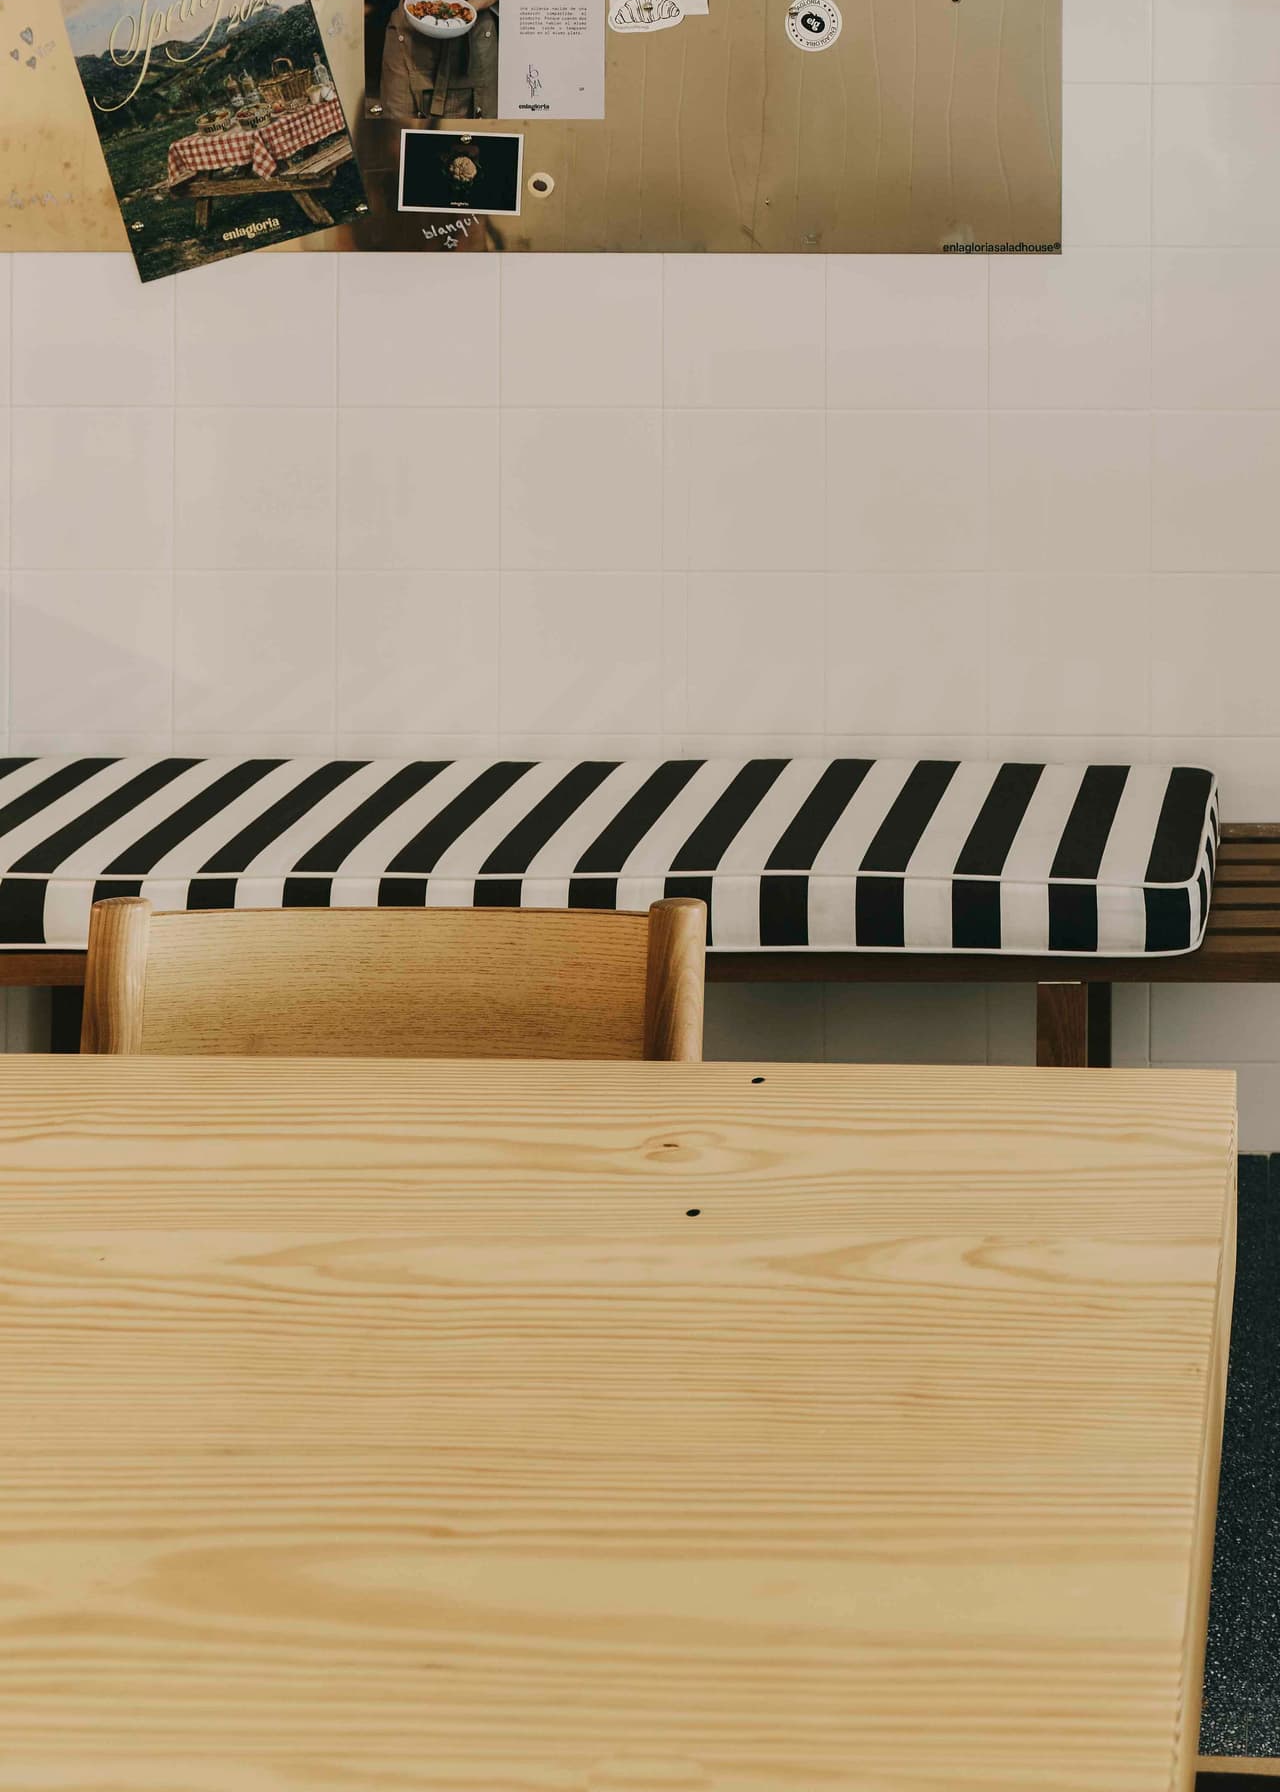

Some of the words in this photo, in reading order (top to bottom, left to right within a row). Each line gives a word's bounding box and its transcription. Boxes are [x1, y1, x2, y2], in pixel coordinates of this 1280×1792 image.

[806, 17, 821, 31] elg
[223, 217, 281, 241] enlagloria
[943, 241, 1062, 254] enlagloriasaladhouse®
